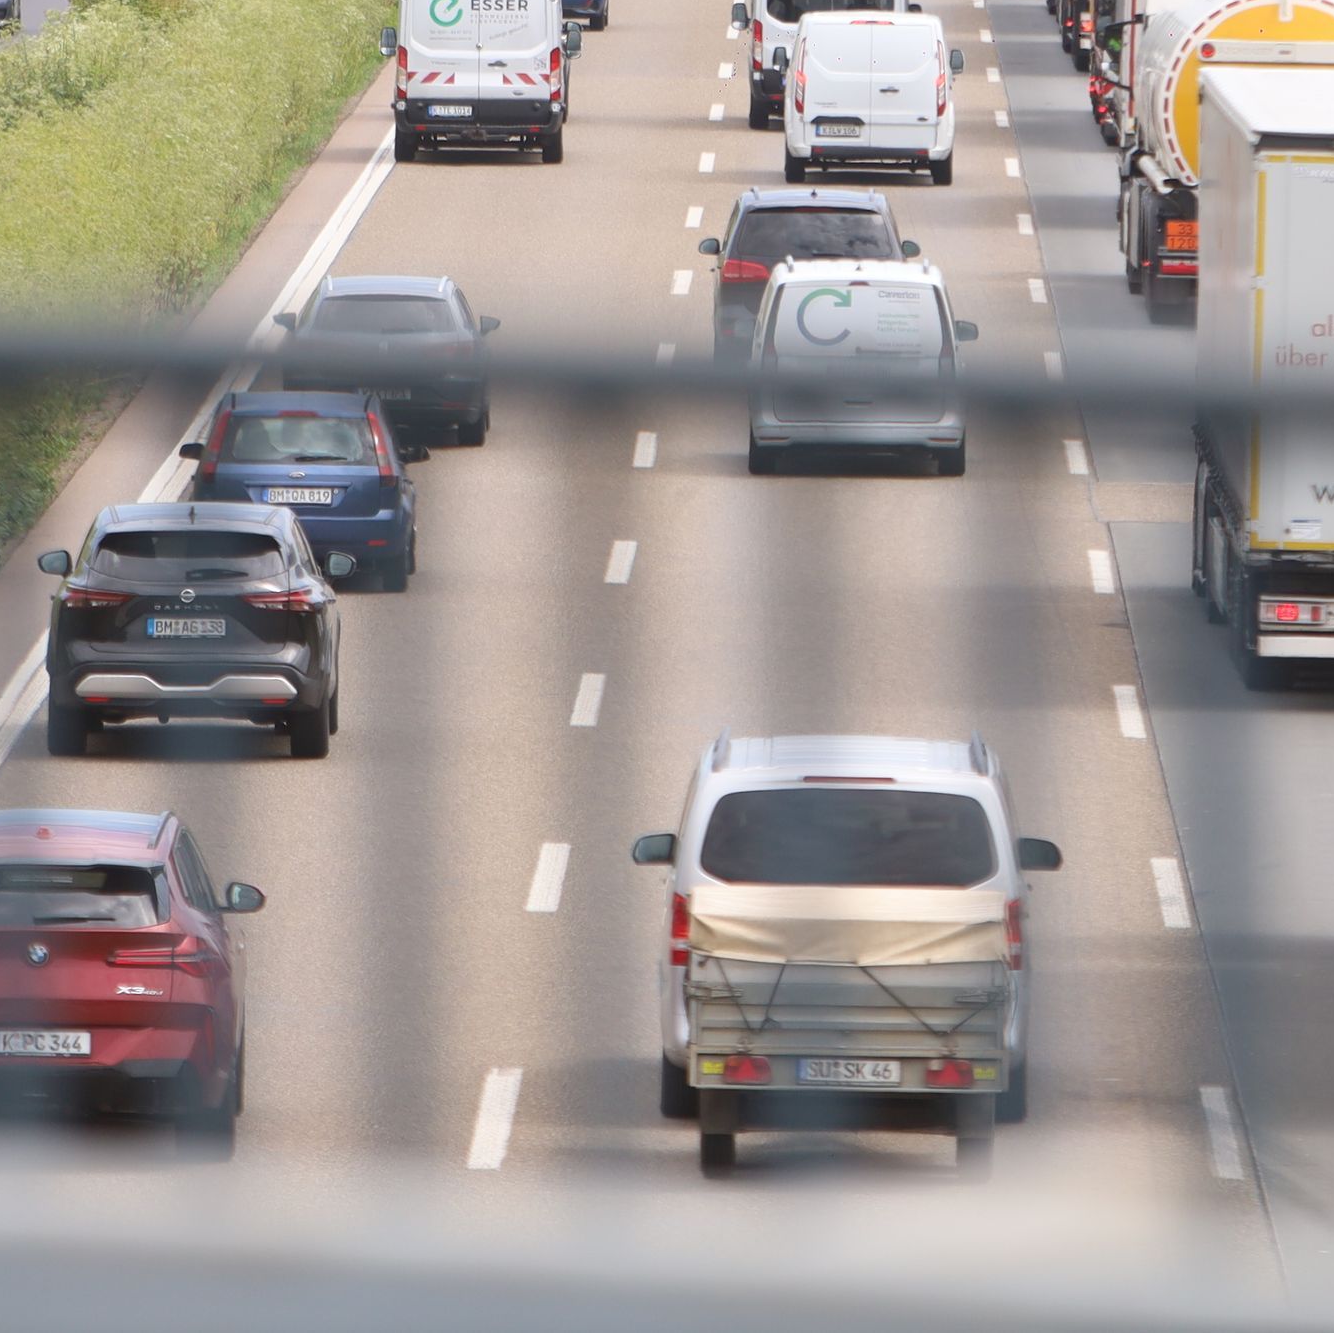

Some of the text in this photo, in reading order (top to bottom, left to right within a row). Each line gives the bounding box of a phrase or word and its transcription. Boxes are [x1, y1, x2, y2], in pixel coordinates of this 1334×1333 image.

[1178, 224, 1194, 235] 33
[1275, 344, 1328, 367] über
[269, 490, 330, 502] BM QA 819
[155, 621, 173, 633] BM
[116, 985, 146, 996] X3
[2, 1033, 15, 1051] K
[49, 1034, 83, 1052] 344
[809, 1060, 893, 1080] SU SK 46
